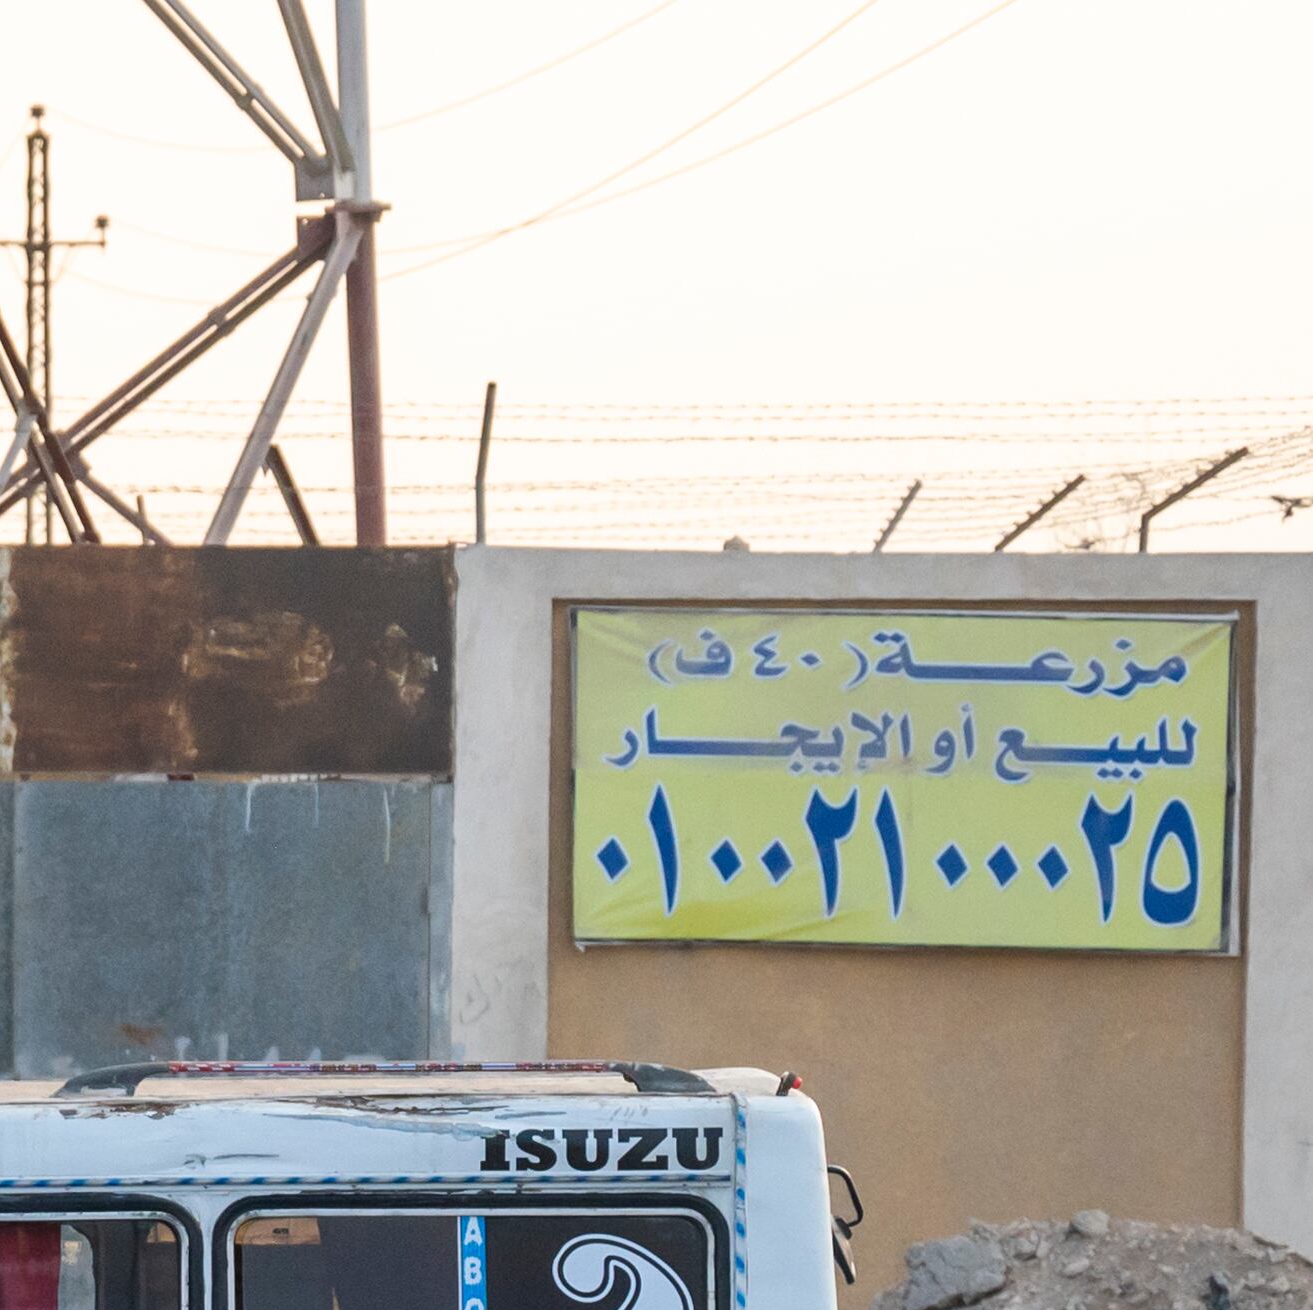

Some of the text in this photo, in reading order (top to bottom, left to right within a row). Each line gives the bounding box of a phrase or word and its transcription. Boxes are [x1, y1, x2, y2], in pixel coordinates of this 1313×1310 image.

[874, 632, 1187, 697] مزرعة
[927, 705, 974, 774] أو
[995, 720, 1197, 781] للبيع
[596, 785, 1199, 925] ٠١٠٠٢١٠٠٠٢٥
[479, 1127, 724, 1172] ISUZU
